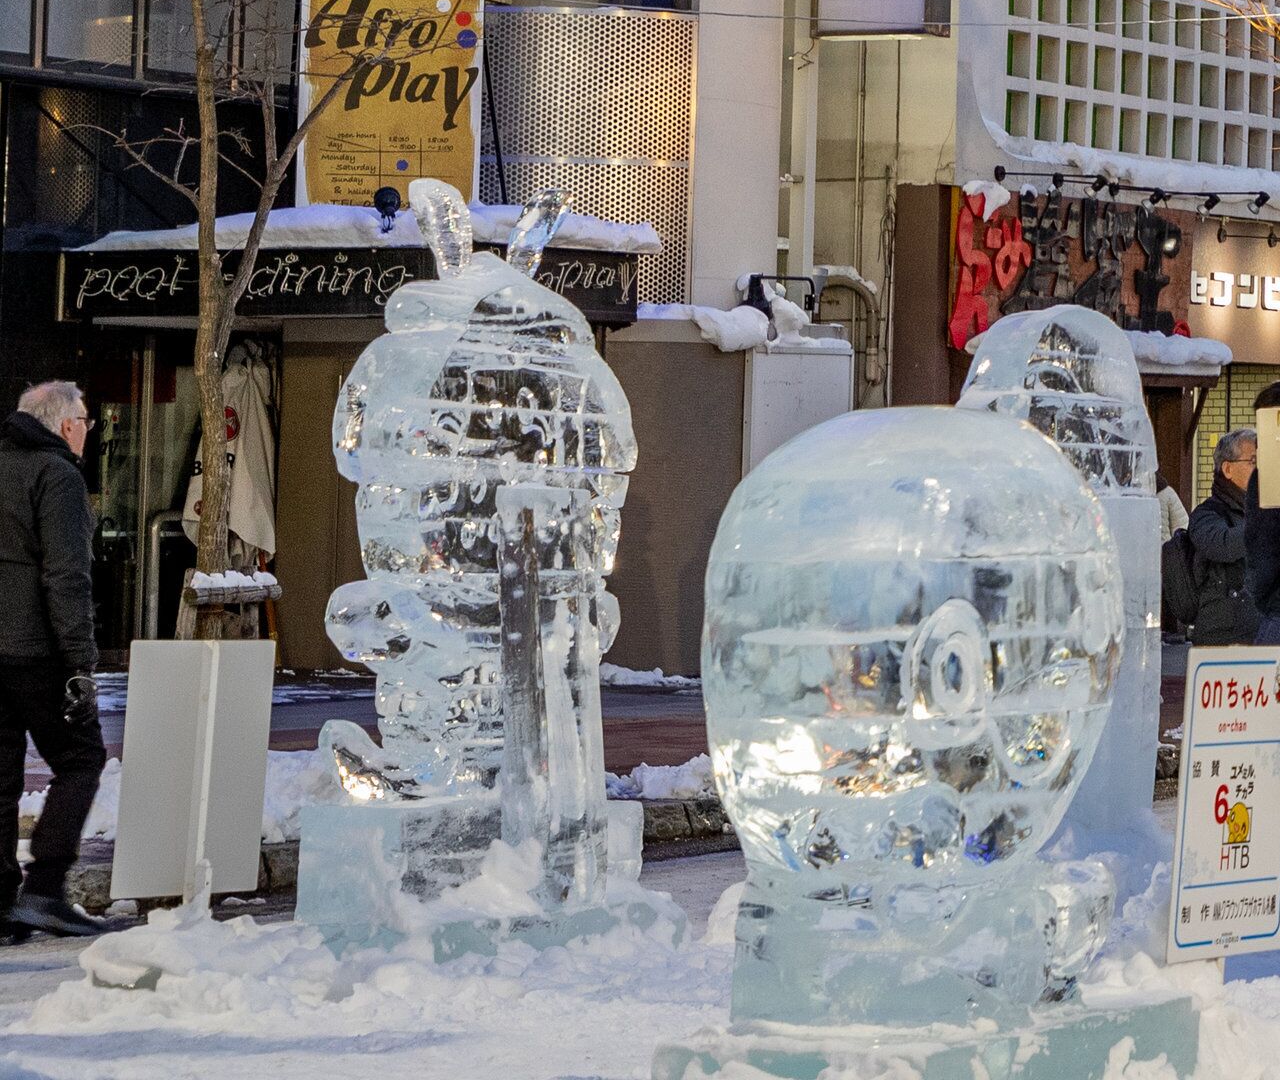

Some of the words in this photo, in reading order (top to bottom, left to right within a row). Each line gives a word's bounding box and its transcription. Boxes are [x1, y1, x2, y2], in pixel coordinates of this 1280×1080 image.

[1201, 676, 1269, 709] onちゃん
[1218, 719, 1247, 732] on-chan
[1235, 781, 1254, 800] チカラ
[1214, 784, 1229, 824] 6
[1220, 845, 1250, 871] HTB
